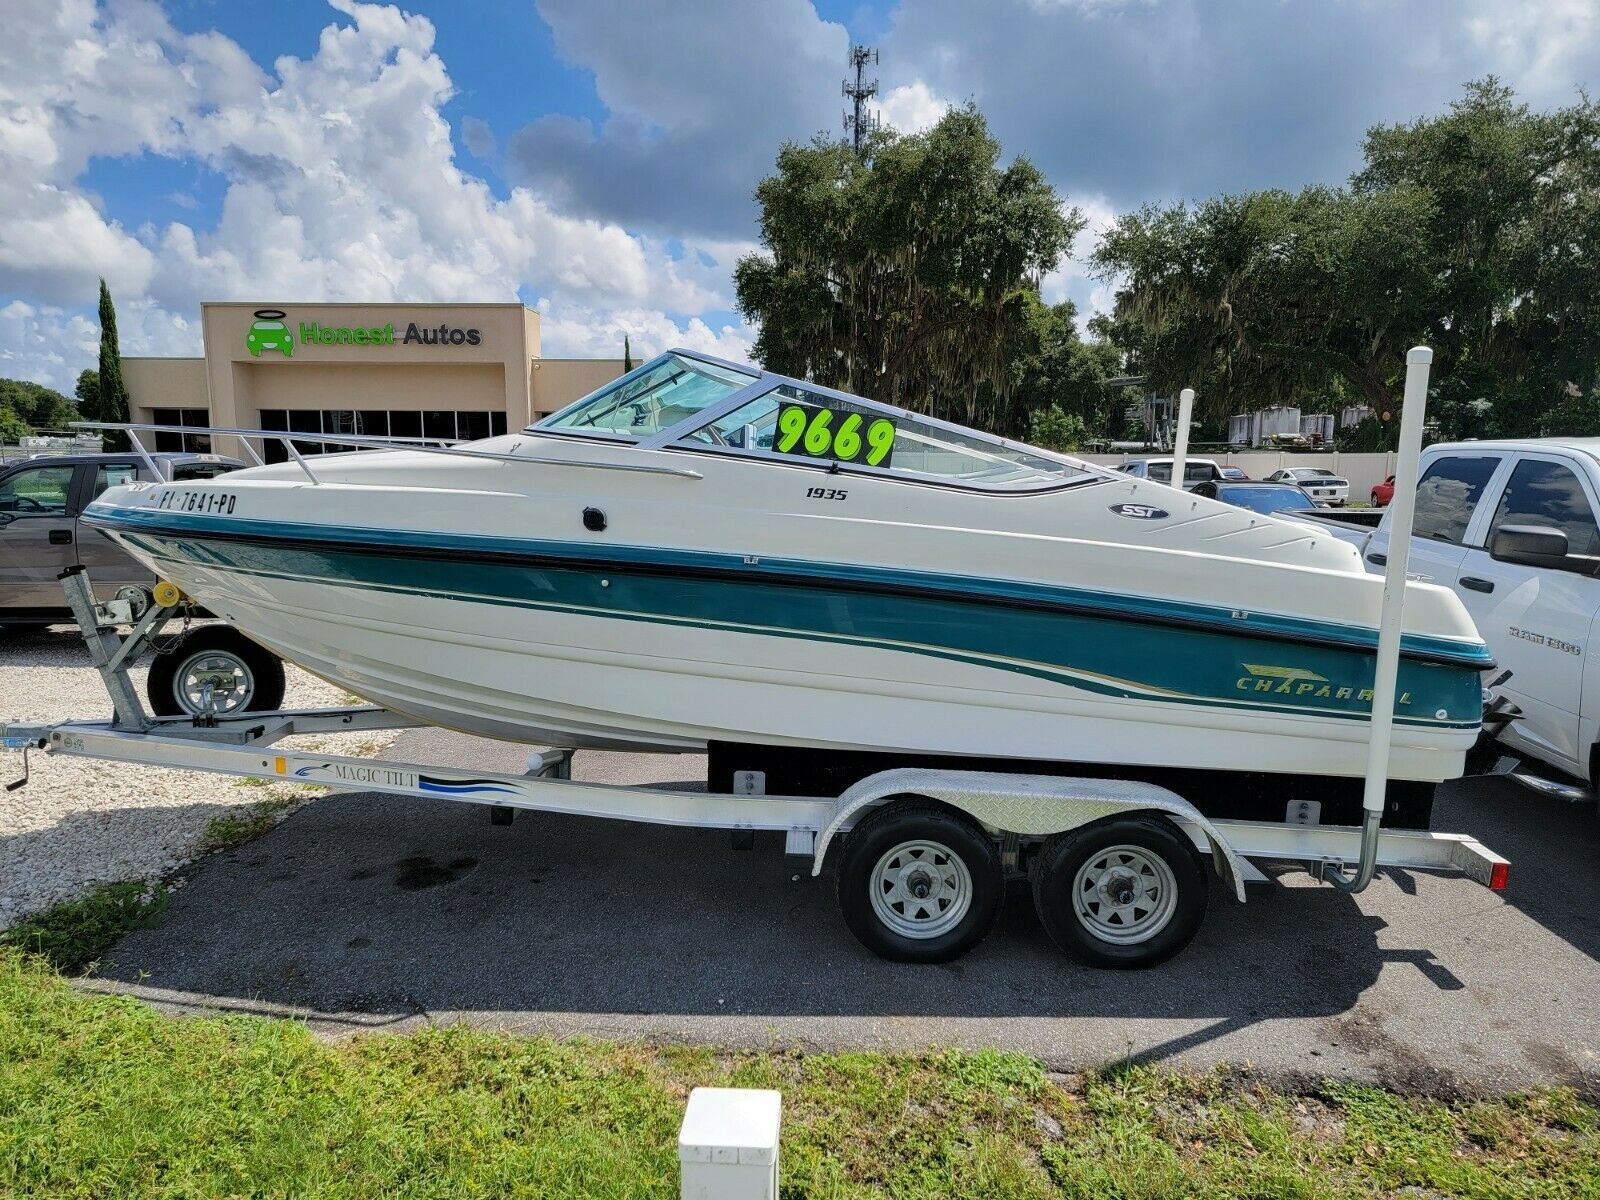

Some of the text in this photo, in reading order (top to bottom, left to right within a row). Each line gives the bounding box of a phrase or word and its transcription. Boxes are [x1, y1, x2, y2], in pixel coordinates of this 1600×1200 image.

[299, 321, 482, 346] Honest Autos
[777, 405, 896, 467] 9669
[806, 487, 848, 501] 1935
[1120, 504, 1160, 518] SST
[1236, 677, 1413, 705] CHAPARRL
[335, 764, 418, 788] MAGIC TILT
